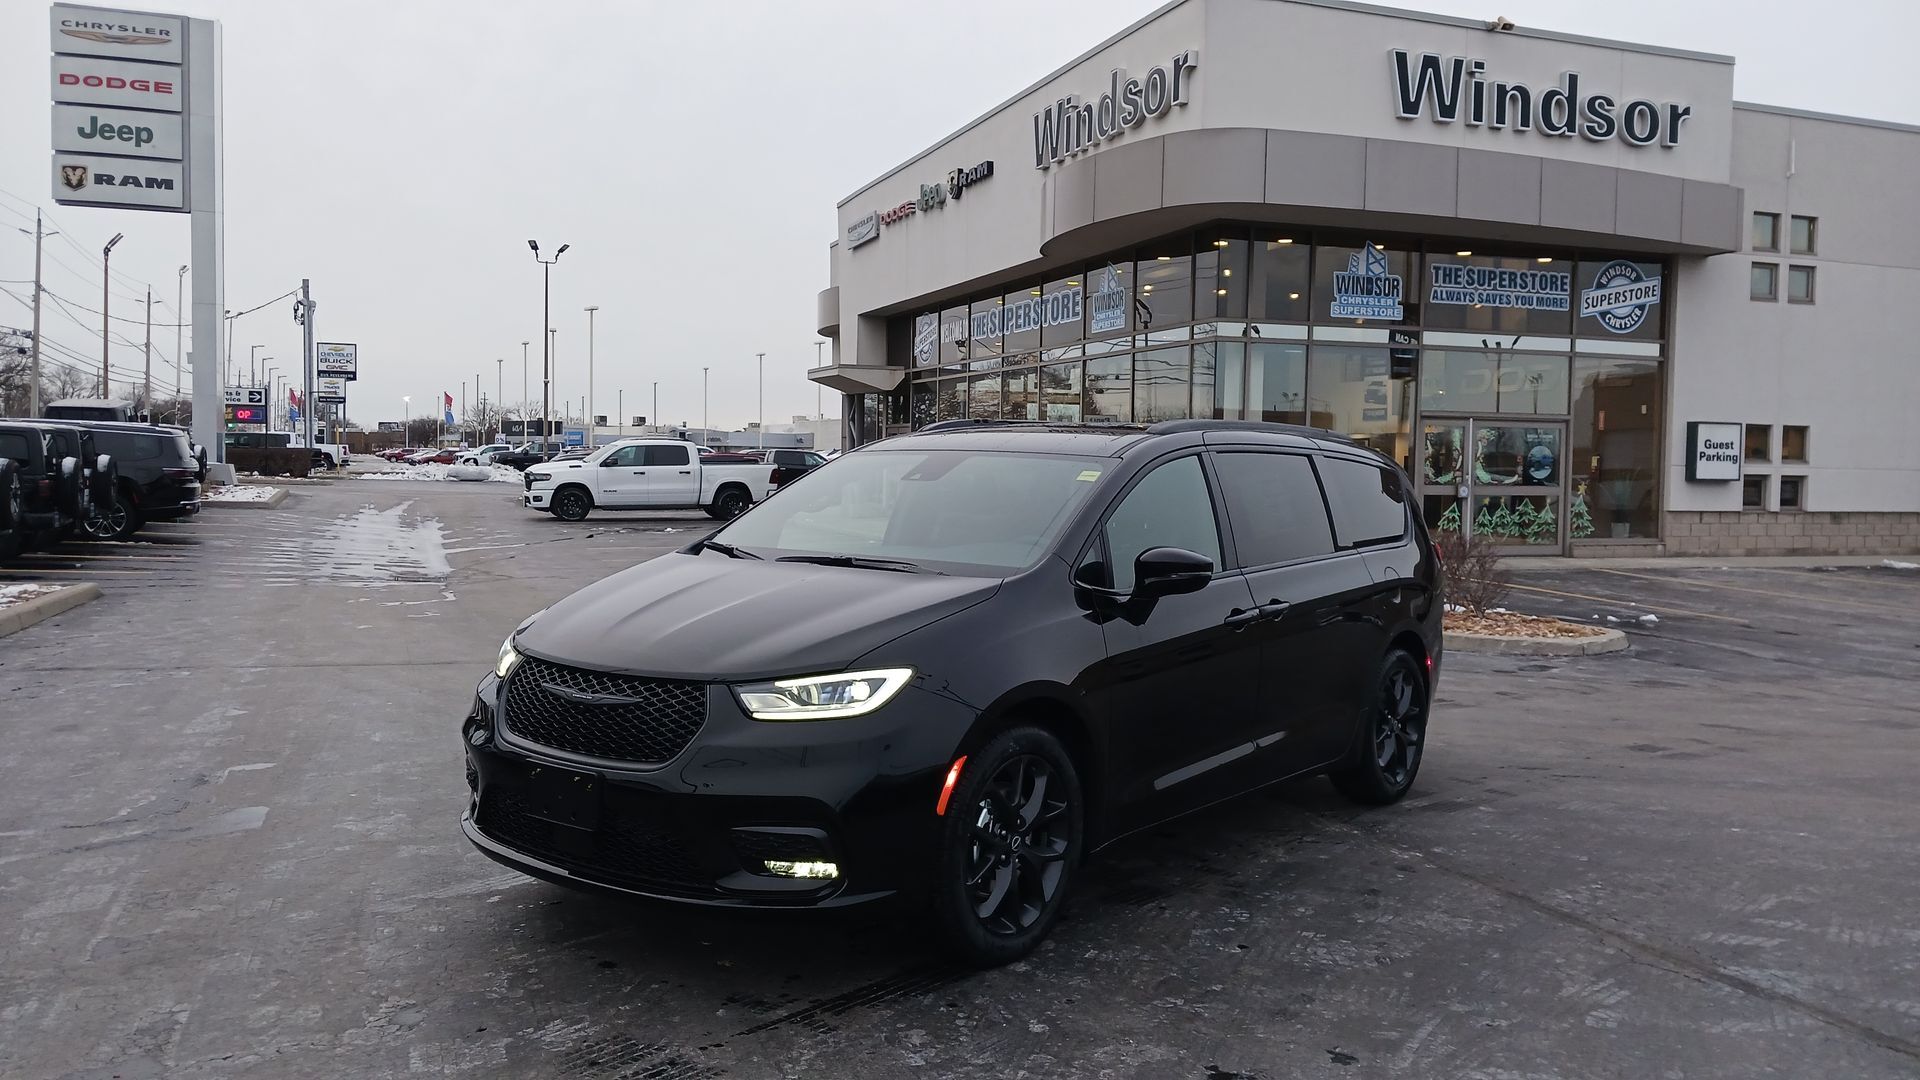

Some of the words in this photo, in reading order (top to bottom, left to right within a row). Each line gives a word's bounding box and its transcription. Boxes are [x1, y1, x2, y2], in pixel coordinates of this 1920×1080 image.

[61, 20, 170, 37] CHRYSLER
[59, 73, 173, 94] DODGE
[1389, 48, 1691, 148] Windsor
[1033, 50, 1197, 169] Windsor
[77, 116, 153, 147] Jeep
[94, 173, 174, 190] RAM
[959, 160, 993, 187] RAM
[917, 183, 946, 211] Jeep
[880, 200, 916, 226] DODGE
[848, 215, 874, 233] CHRYSLER
[1432, 265, 1462, 286] THE
[1465, 268, 1569, 293] SUPERSTORE
[1600, 266, 1637, 284] WINDSOR
[1336, 275, 1400, 297] WINDSOR
[1093, 289, 1124, 313] WINDSOR
[1341, 296, 1394, 306] CHRYSLER
[1432, 289, 1475, 304] ALWAYS
[1478, 291, 1512, 306] SAVES
[1514, 294, 1534, 308] YOU
[1536, 296, 1568, 309] MORE!
[1584, 284, 1658, 310] SUPERSTORE
[971, 313, 987, 339] THE
[988, 288, 1082, 339] SUPERSTORE
[1333, 305, 1400, 317] SUPERSTORE
[1606, 307, 1642, 328] CHRYSLER
[1704, 438, 1734, 450] Guest
[1699, 451, 1738, 464] Parking
